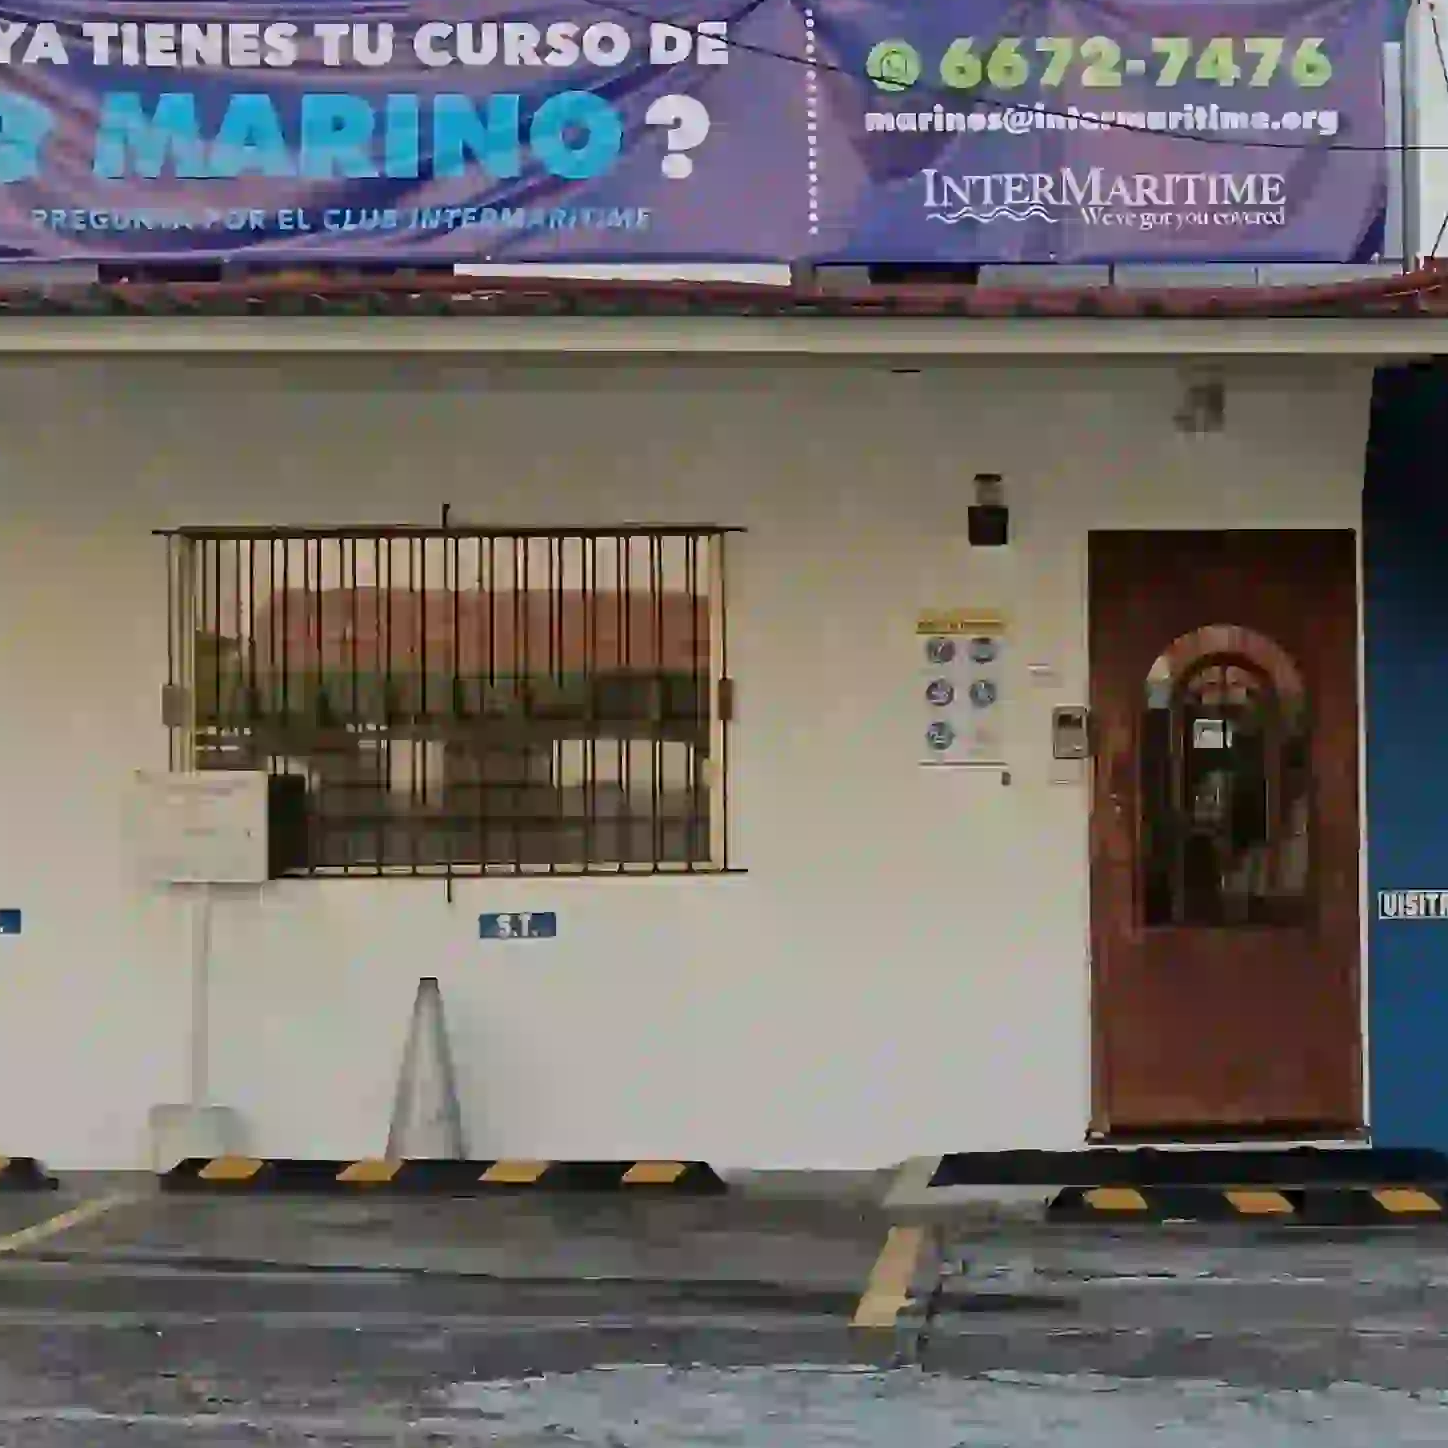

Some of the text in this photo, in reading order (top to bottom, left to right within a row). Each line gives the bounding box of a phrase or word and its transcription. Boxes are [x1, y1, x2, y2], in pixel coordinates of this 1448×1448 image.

[82, 22, 299, 67] TIENES
[313, 23, 393, 67] TU
[413, 20, 631, 68] CURSO
[649, 21, 729, 67] DE
[939, 36, 1334, 89] 6672-7476
[278, 208, 311, 230] EL
[323, 208, 398, 232] CLUB
